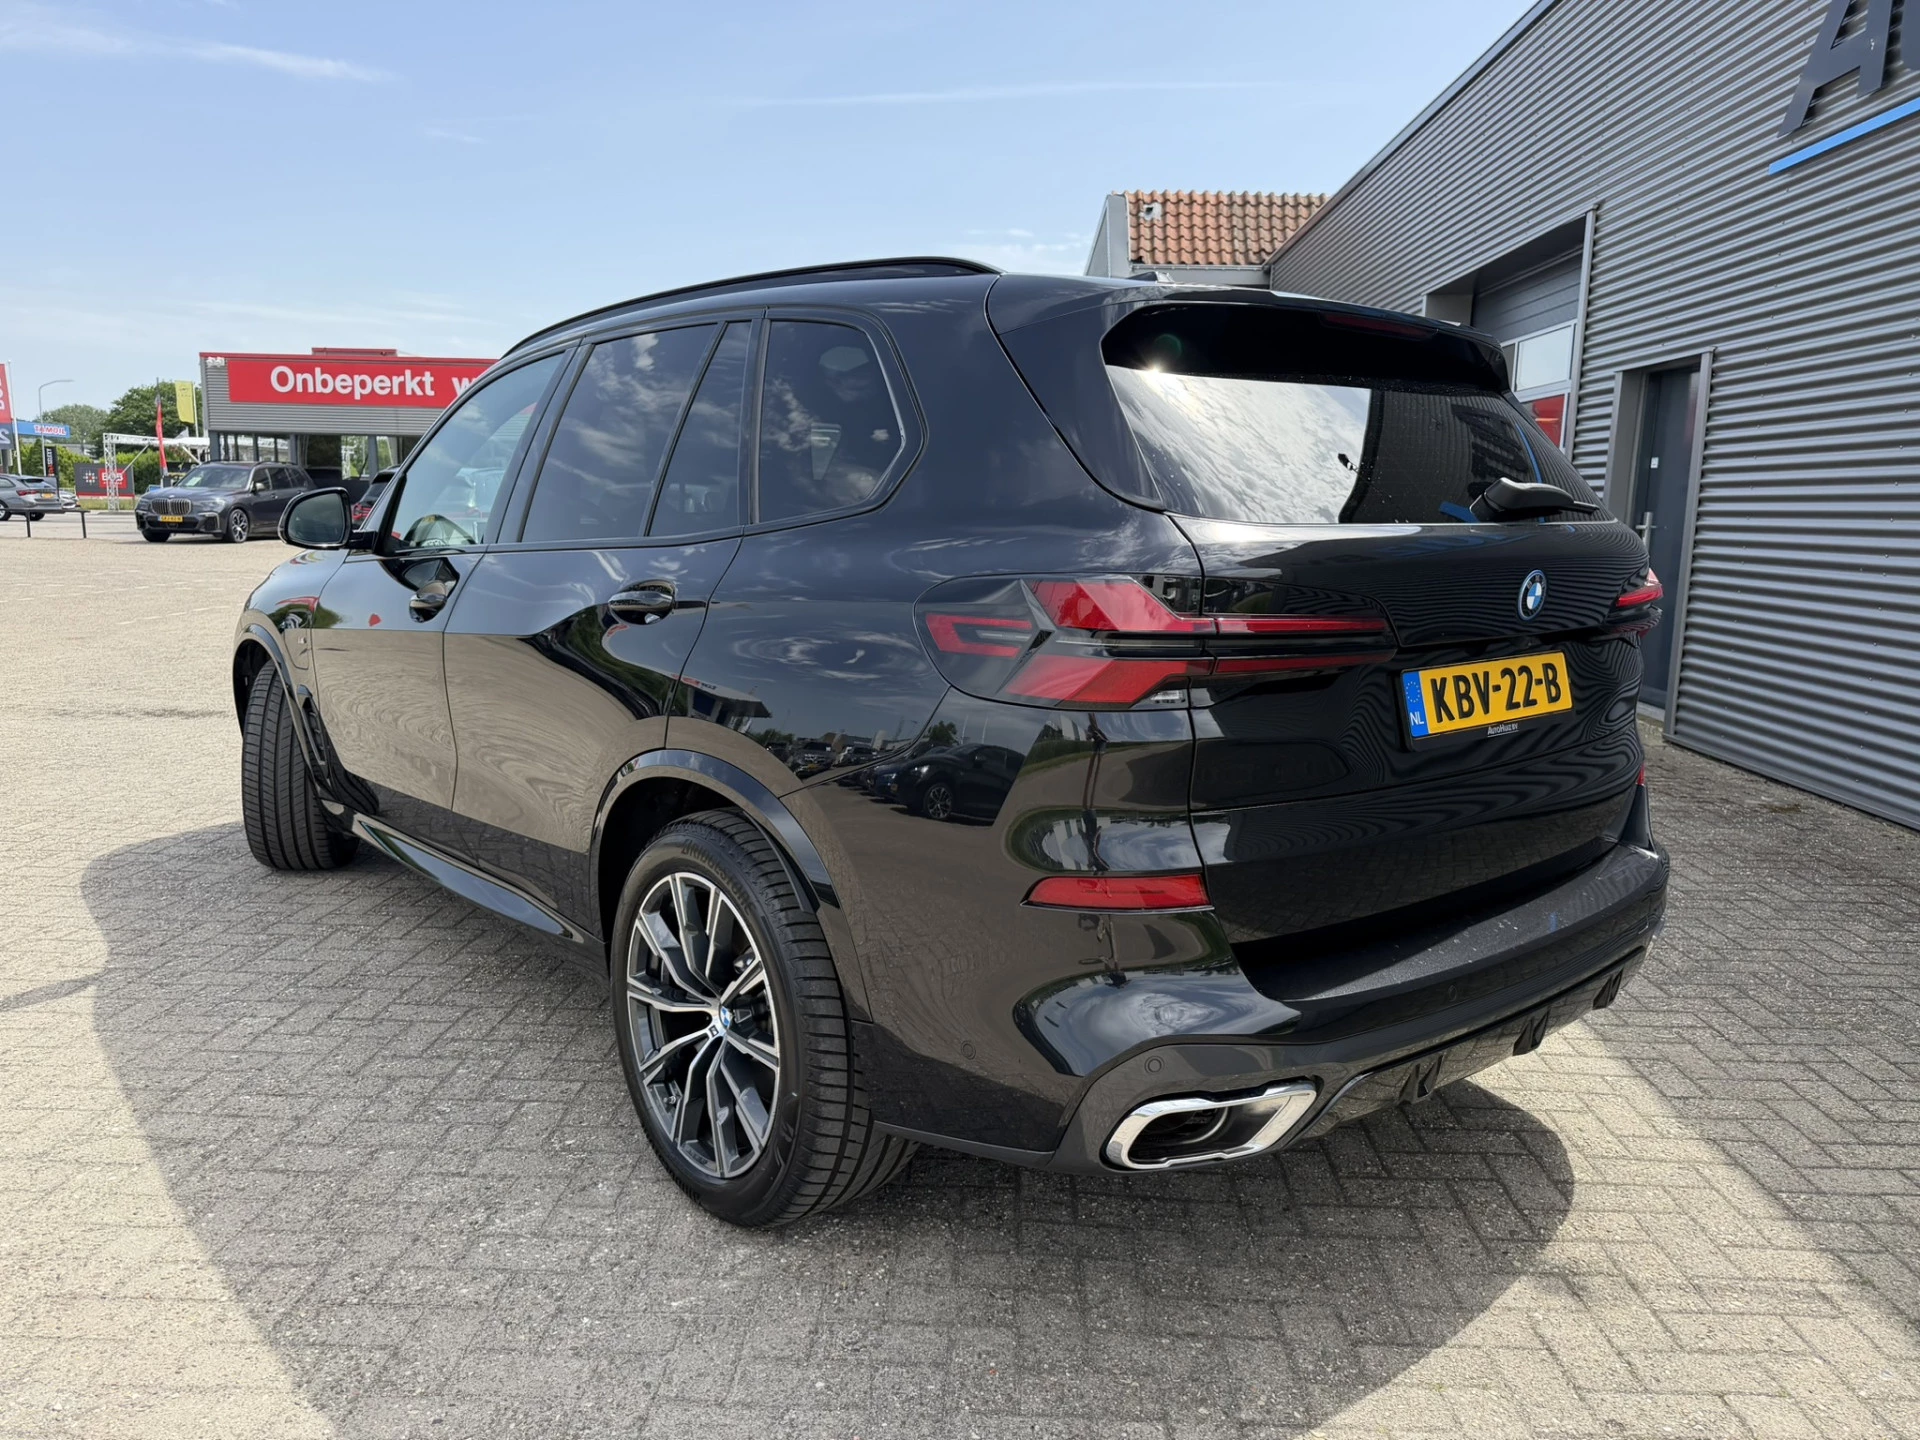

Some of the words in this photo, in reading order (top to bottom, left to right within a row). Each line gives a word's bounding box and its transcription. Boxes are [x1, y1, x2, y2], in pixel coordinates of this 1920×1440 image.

[271, 366, 435, 400] Onbeperkt
[34, 425, 67, 436] TAMOIL
[1430, 662, 1562, 723] KBV-22-B
[1410, 711, 1425, 726] NL
